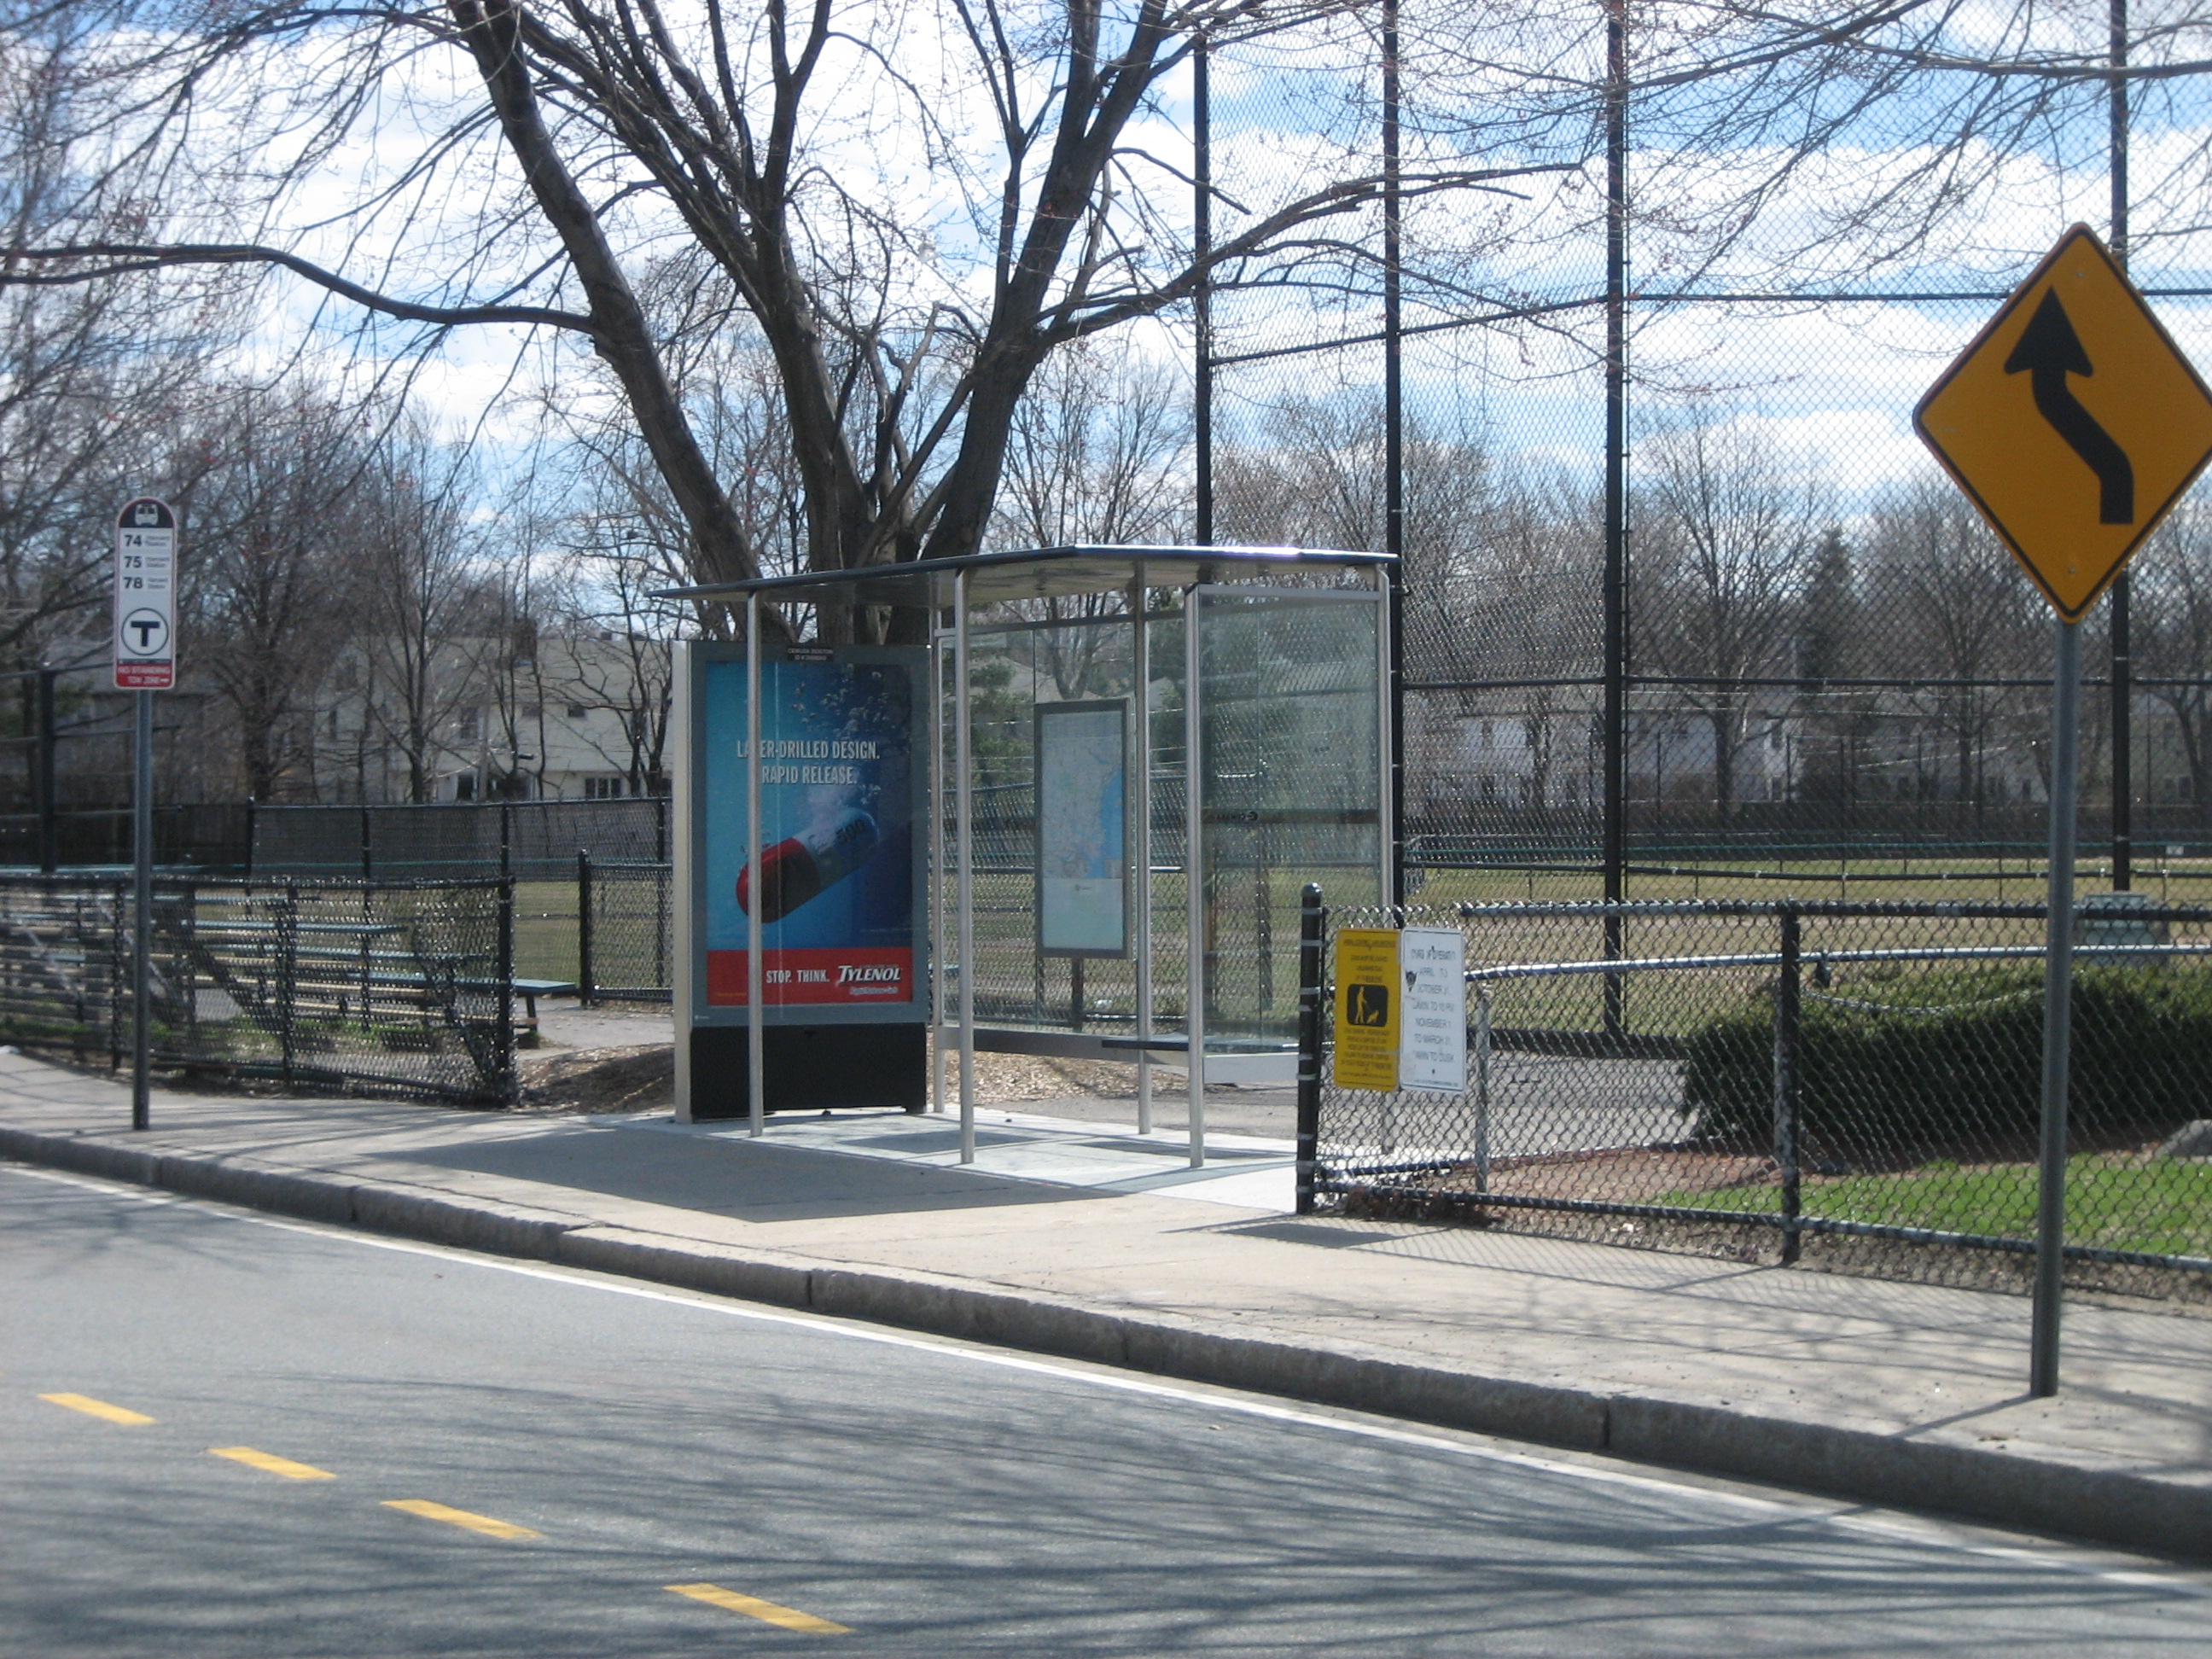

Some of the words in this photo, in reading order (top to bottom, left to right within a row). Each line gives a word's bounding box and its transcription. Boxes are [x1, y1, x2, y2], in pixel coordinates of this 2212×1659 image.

[124, 534, 143, 547] 74
[124, 556, 143, 568] 75
[124, 577, 143, 589] 78
[131, 620, 160, 647] T
[737, 740, 829, 759] LAER-DRILLED
[832, 741, 881, 760] DESIGN.
[762, 766, 799, 784] RAPID
[802, 766, 858, 784] RELEASE.
[835, 818, 866, 845] 500
[766, 969, 792, 983] STOP.
[797, 969, 830, 982] THINK.
[837, 965, 901, 982] TYLENOL
